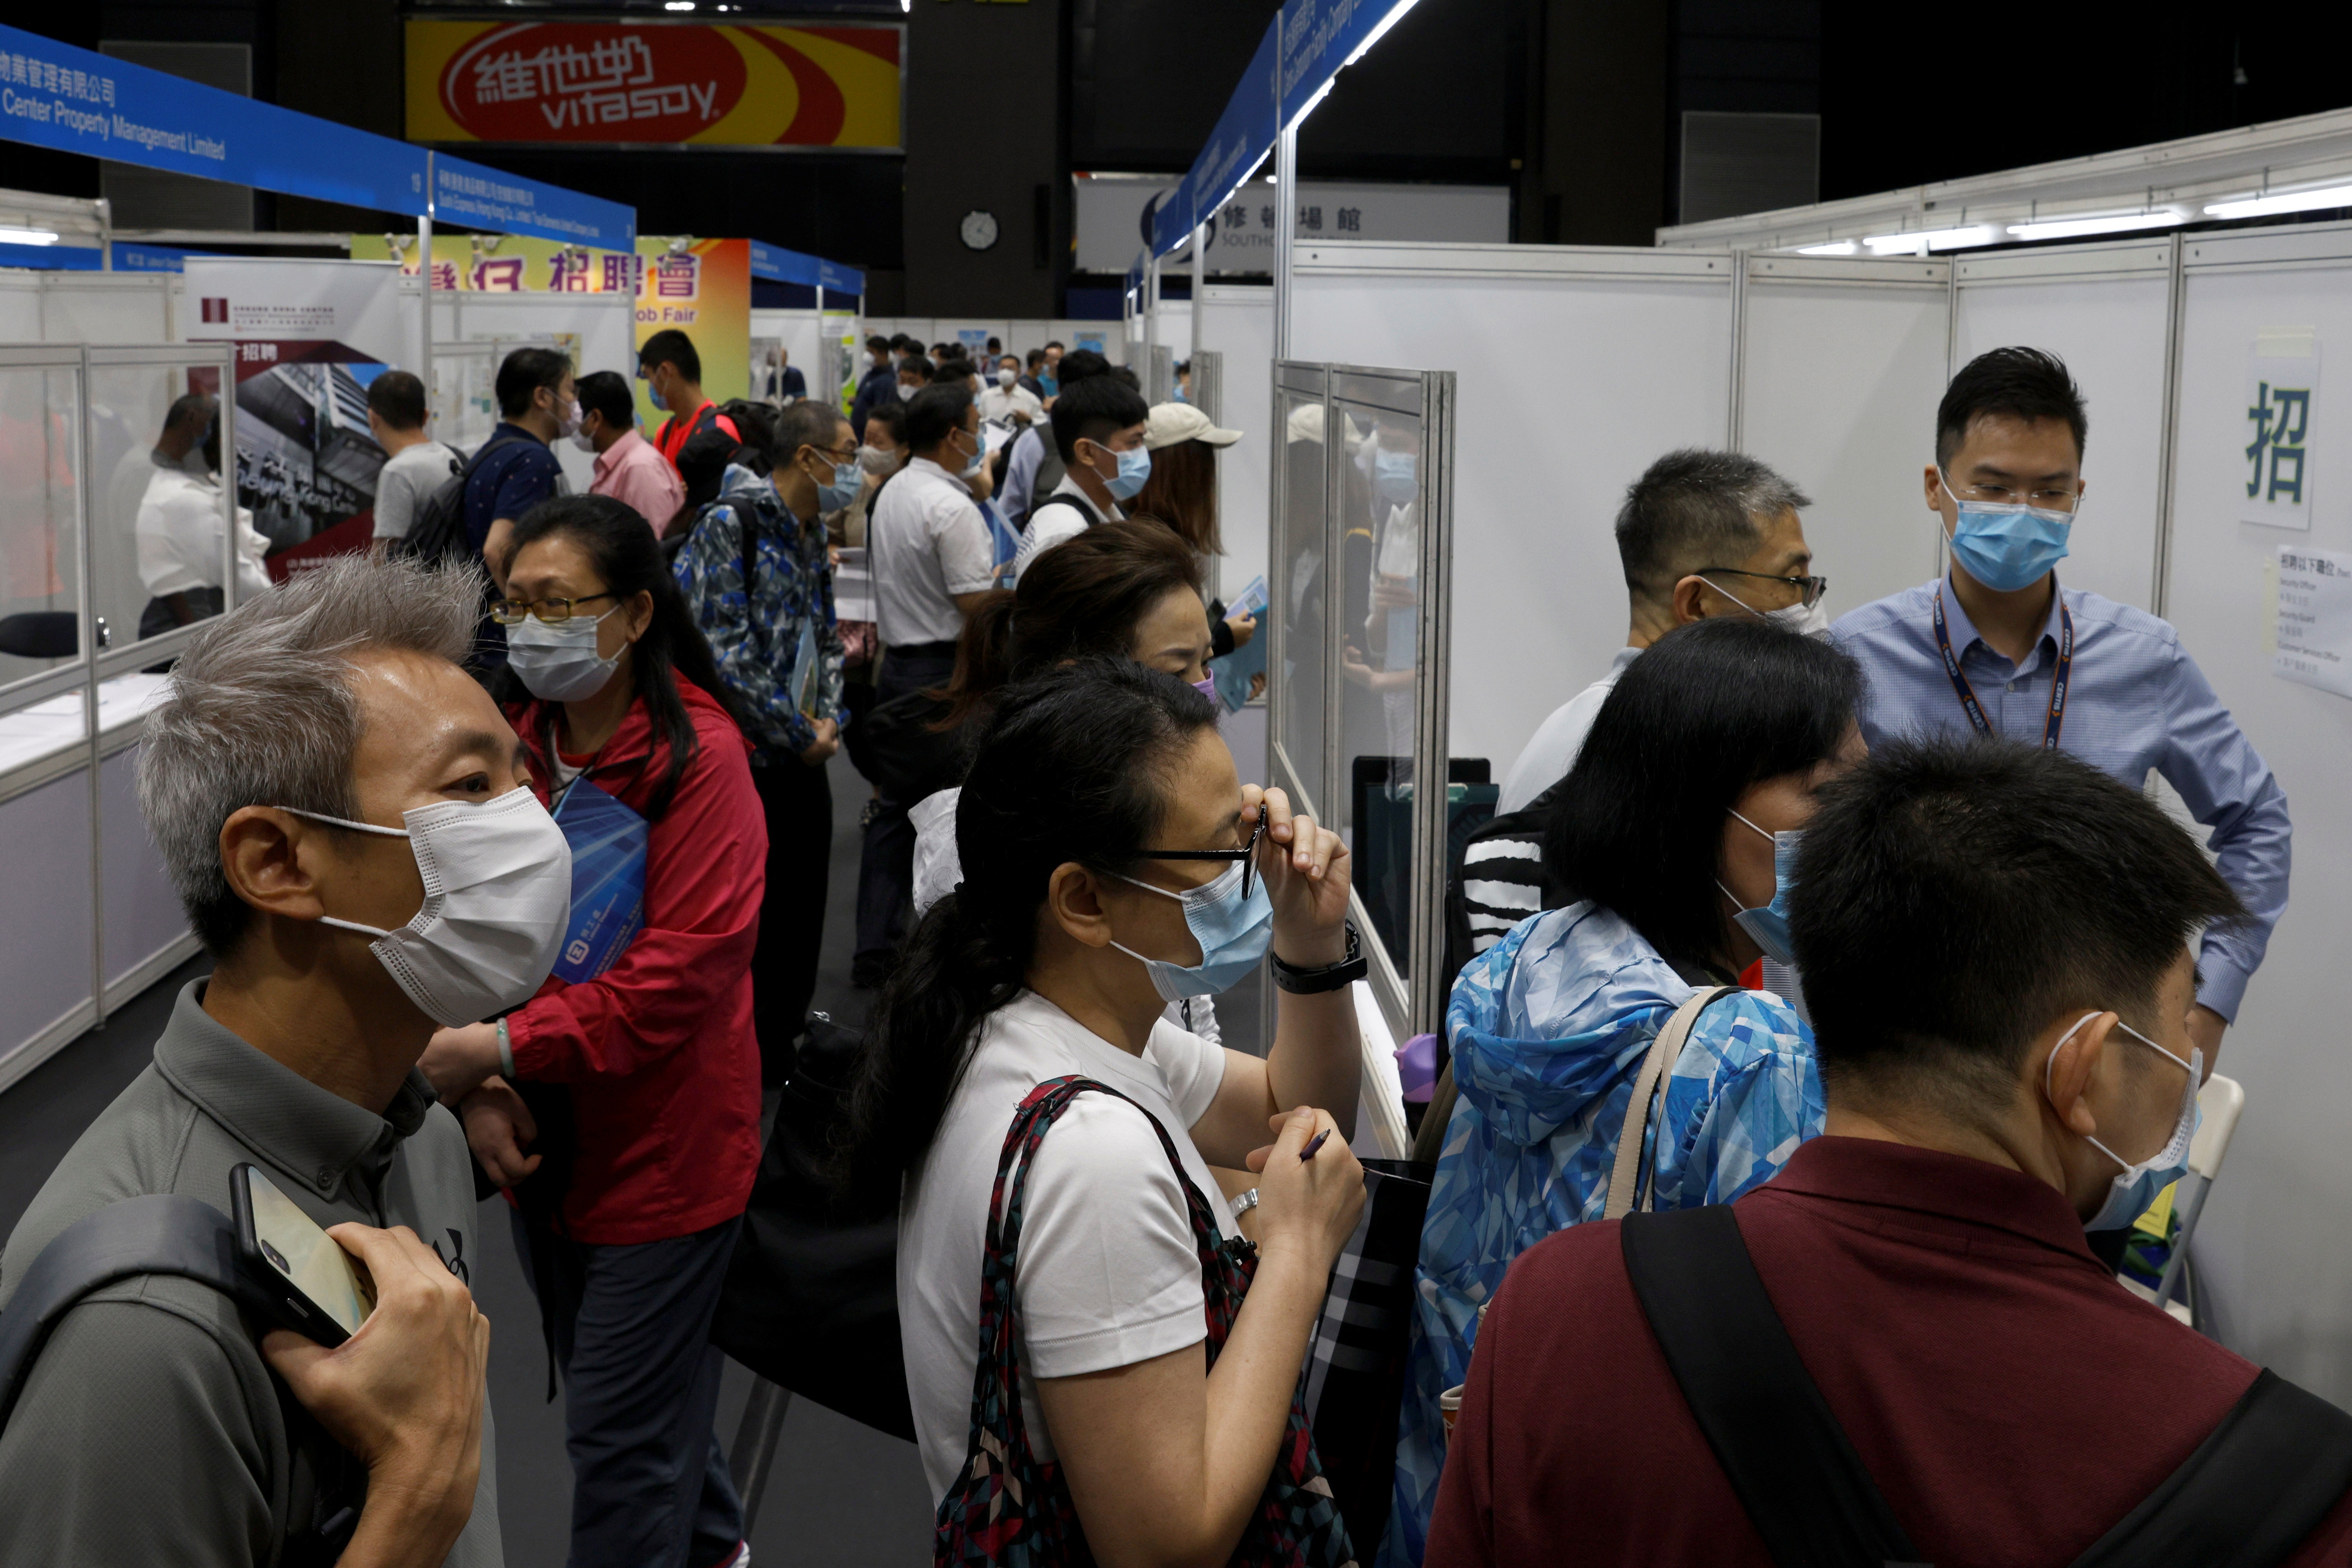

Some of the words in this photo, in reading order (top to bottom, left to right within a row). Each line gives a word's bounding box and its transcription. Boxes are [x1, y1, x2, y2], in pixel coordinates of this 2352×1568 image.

[474, 36, 655, 105] 維他奶
[2, 88, 52, 122] Center
[54, 100, 111, 141] Property
[112, 114, 187, 151] Management
[187, 132, 225, 160] Limited
[635, 308, 658, 323] ob
[663, 307, 695, 323] Fair
[242, 343, 278, 361] 招聘
[2246, 382, 2311, 504] 招
[1944, 648, 1958, 676] CERTIS
[2053, 682, 2064, 710] CERTIS
[1966, 700, 1985, 728] CERTIS
